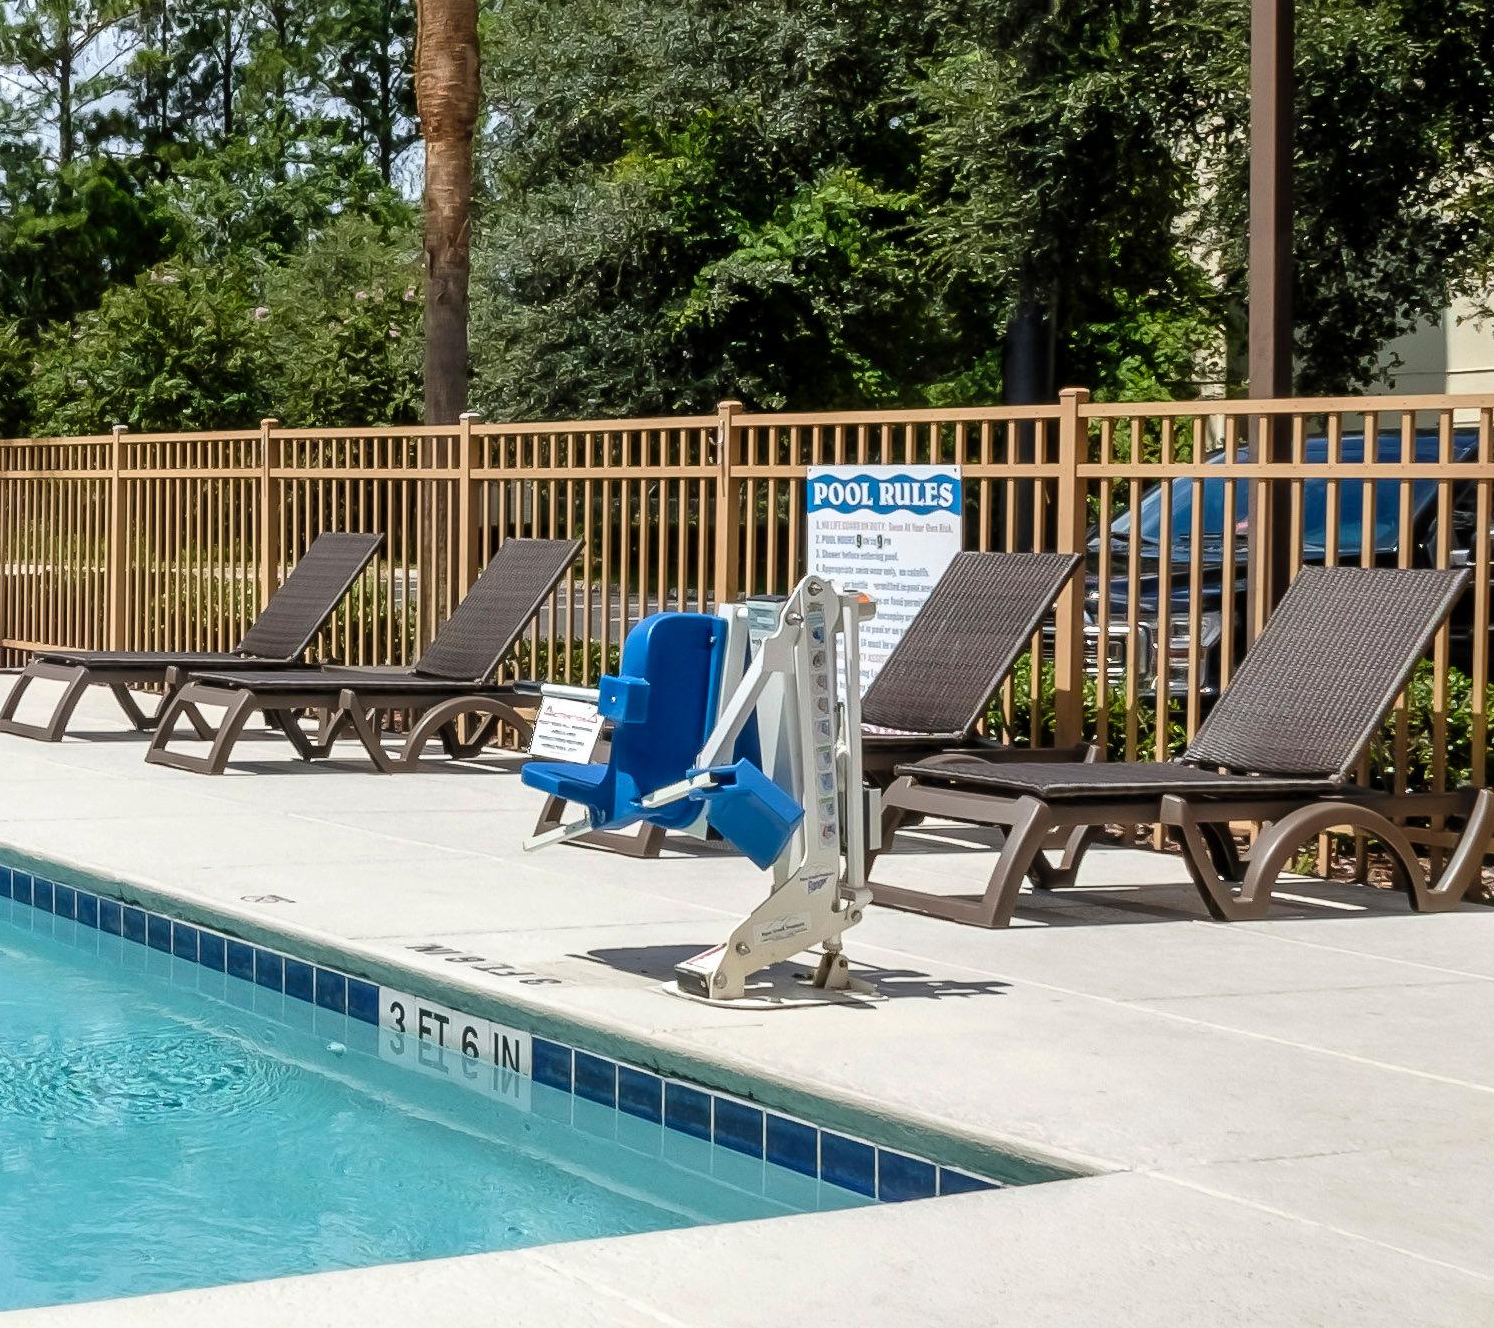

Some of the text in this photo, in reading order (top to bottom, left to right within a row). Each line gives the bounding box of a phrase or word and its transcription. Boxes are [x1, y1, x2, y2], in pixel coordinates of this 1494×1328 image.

[813, 482, 954, 507] POOL RULES
[390, 1001, 520, 1072] 3 FT 6 IN
